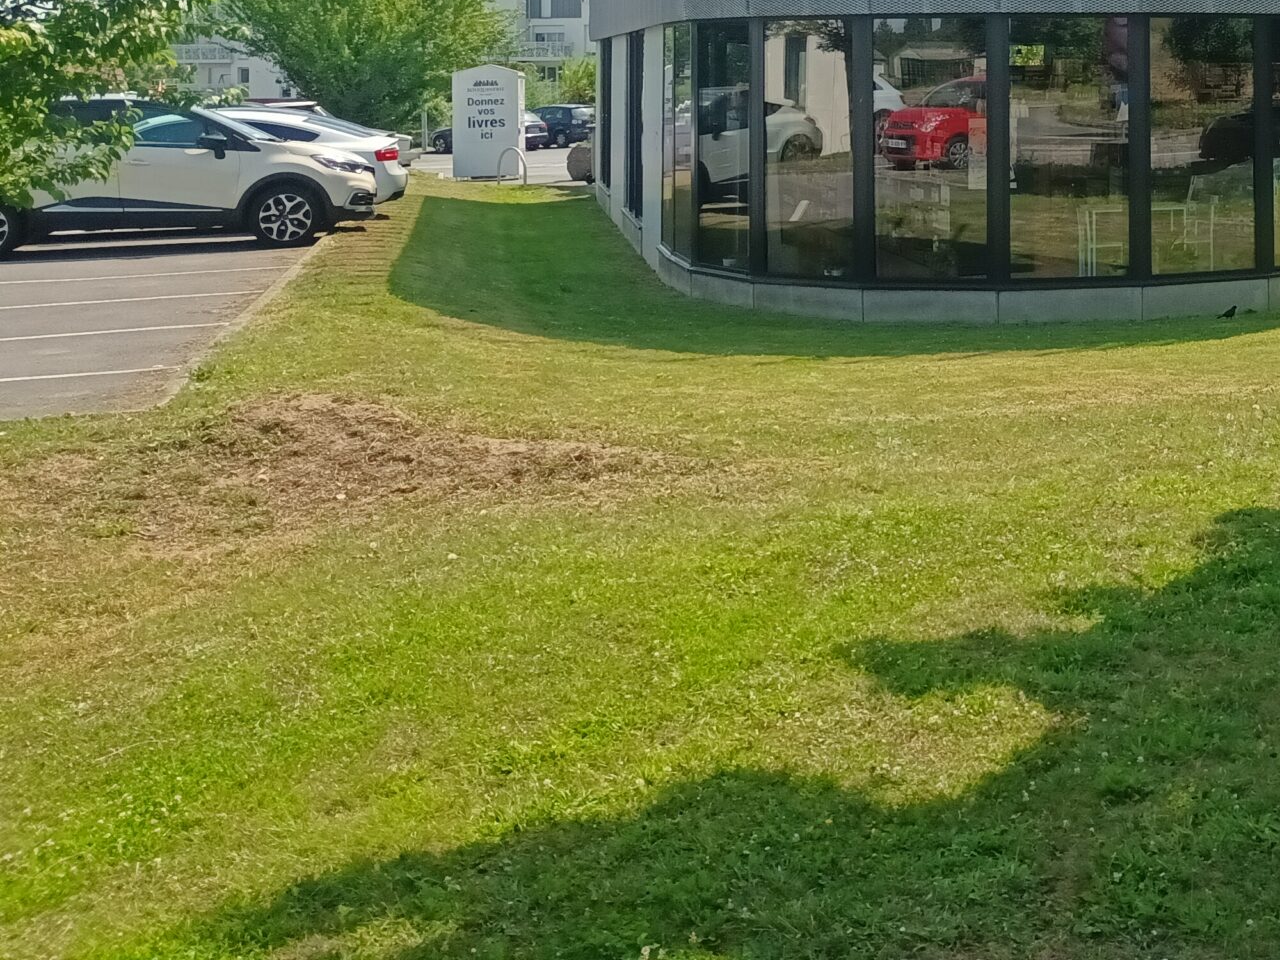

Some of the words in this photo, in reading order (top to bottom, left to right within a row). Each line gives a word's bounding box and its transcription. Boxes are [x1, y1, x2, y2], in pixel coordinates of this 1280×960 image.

[467, 97, 505, 106] Donnez
[467, 116, 506, 129] livres
[480, 129, 493, 140] ici
